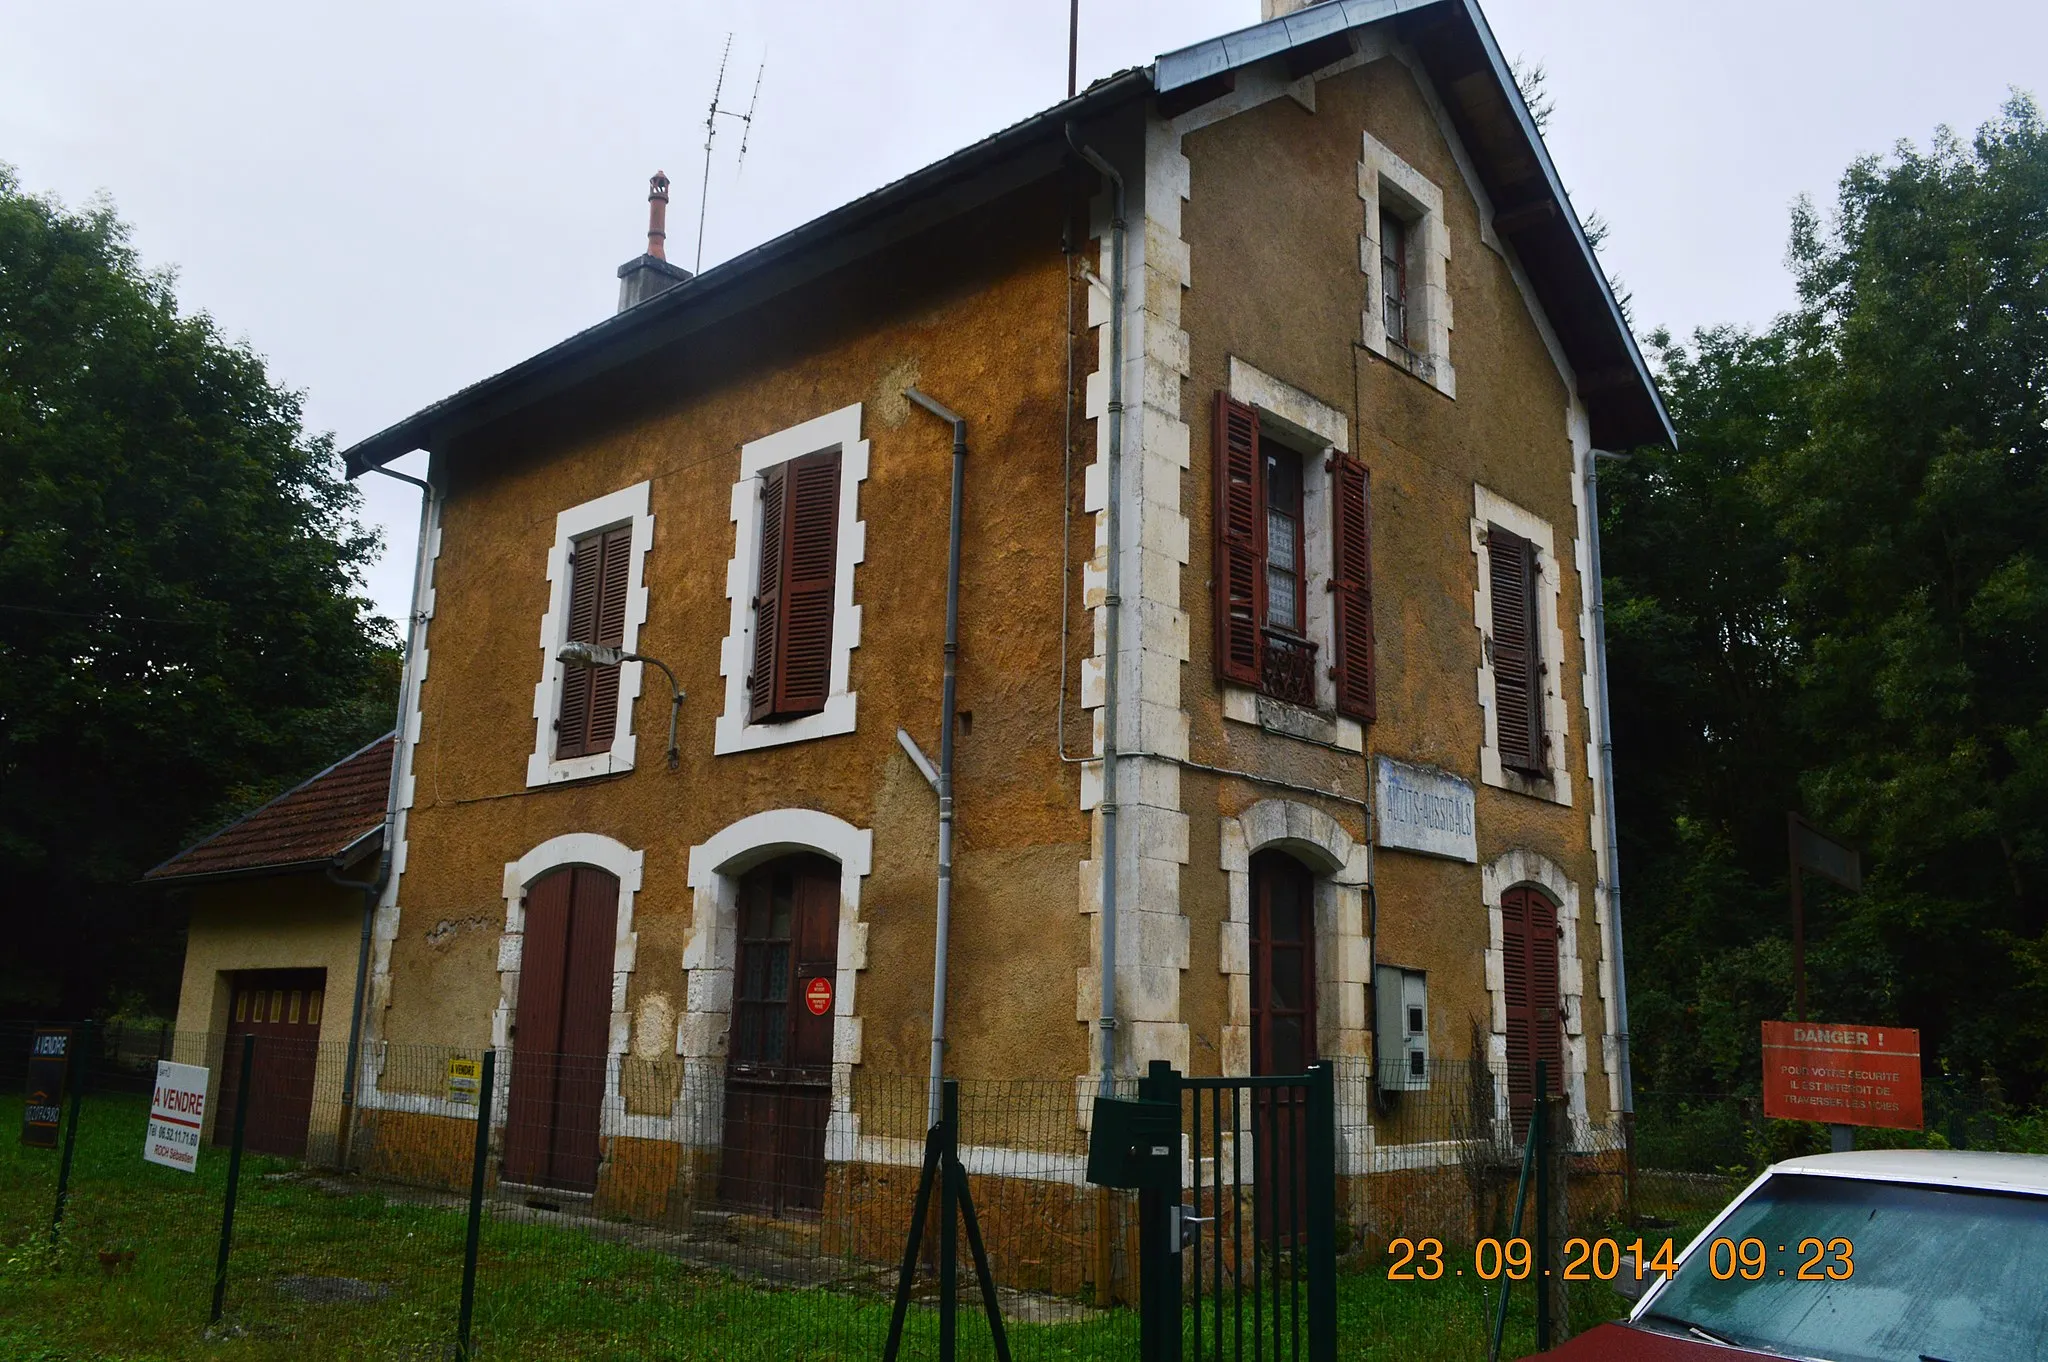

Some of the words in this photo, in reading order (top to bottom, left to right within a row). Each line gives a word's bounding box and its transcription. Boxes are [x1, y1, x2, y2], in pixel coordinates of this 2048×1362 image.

[40, 1036, 67, 1055] VENDRE
[1793, 1028, 1869, 1046] DANGER
[1878, 1032, 1884, 1046] !
[1781, 1065, 1809, 1077] POUR
[1811, 1067, 1846, 1078] VOTRE
[1790, 1080, 1799, 1089] IL
[1802, 1081, 1821, 1091] EST
[1824, 1083, 1873, 1095] INTERDIT
[1875, 1087, 1891, 1096] DE
[153, 1087, 160, 1106] A
[163, 1088, 204, 1115] VENDRE
[1783, 1094, 1844, 1108] TRAVERSER
[1846, 1100, 1866, 1110] LES
[1868, 1101, 1899, 1112] VOIES
